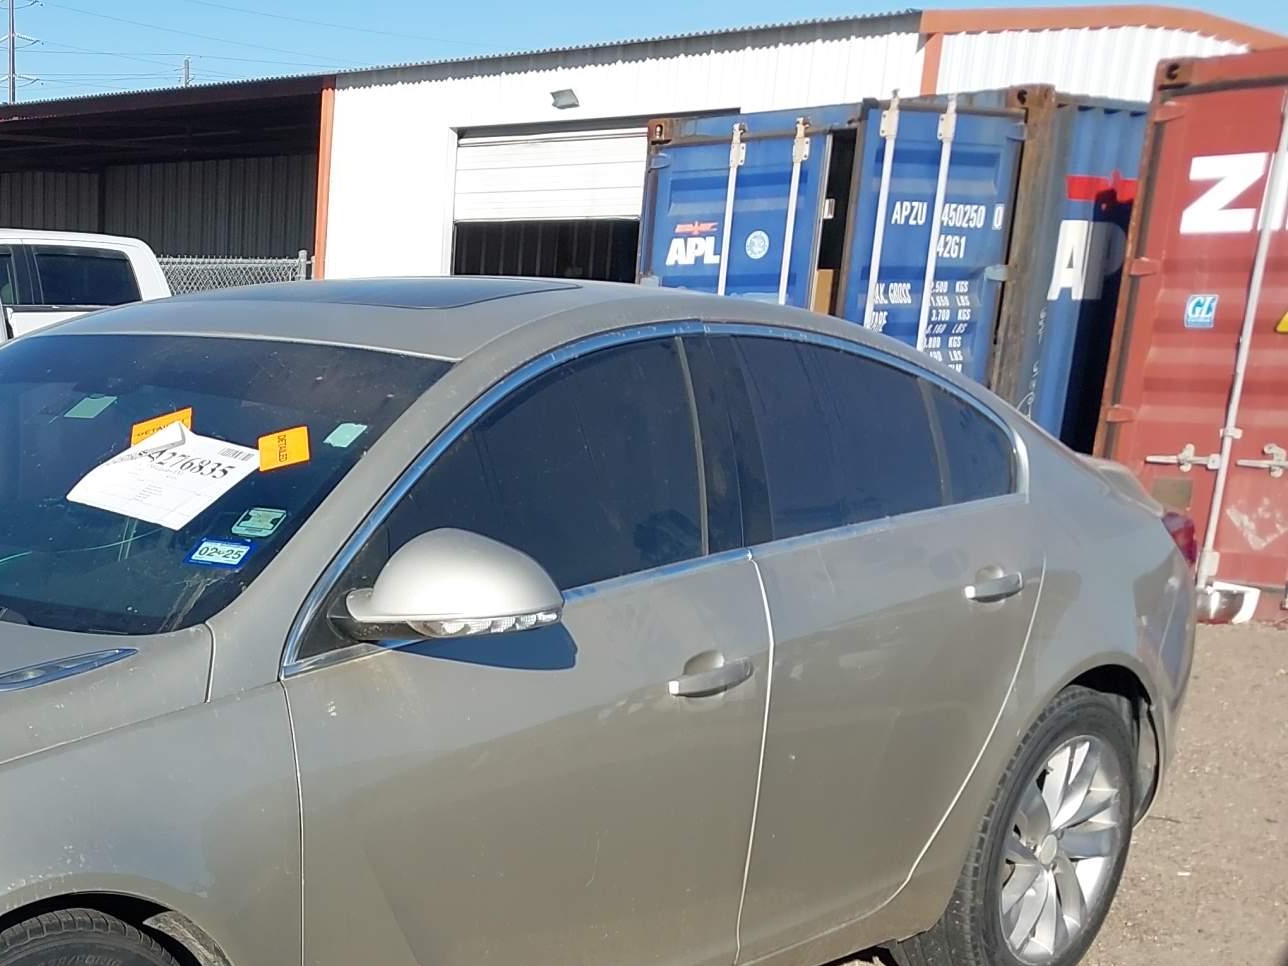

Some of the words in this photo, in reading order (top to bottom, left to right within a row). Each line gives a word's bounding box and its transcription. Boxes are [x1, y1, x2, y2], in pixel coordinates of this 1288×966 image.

[891, 201, 928, 225] APZU
[941, 203, 986, 228] 450250
[666, 236, 720, 266] APL
[937, 234, 966, 259] 42G1
[889, 282, 911, 304] GROSS
[955, 280, 969, 293] KGS
[957, 309, 971, 321] KGS
